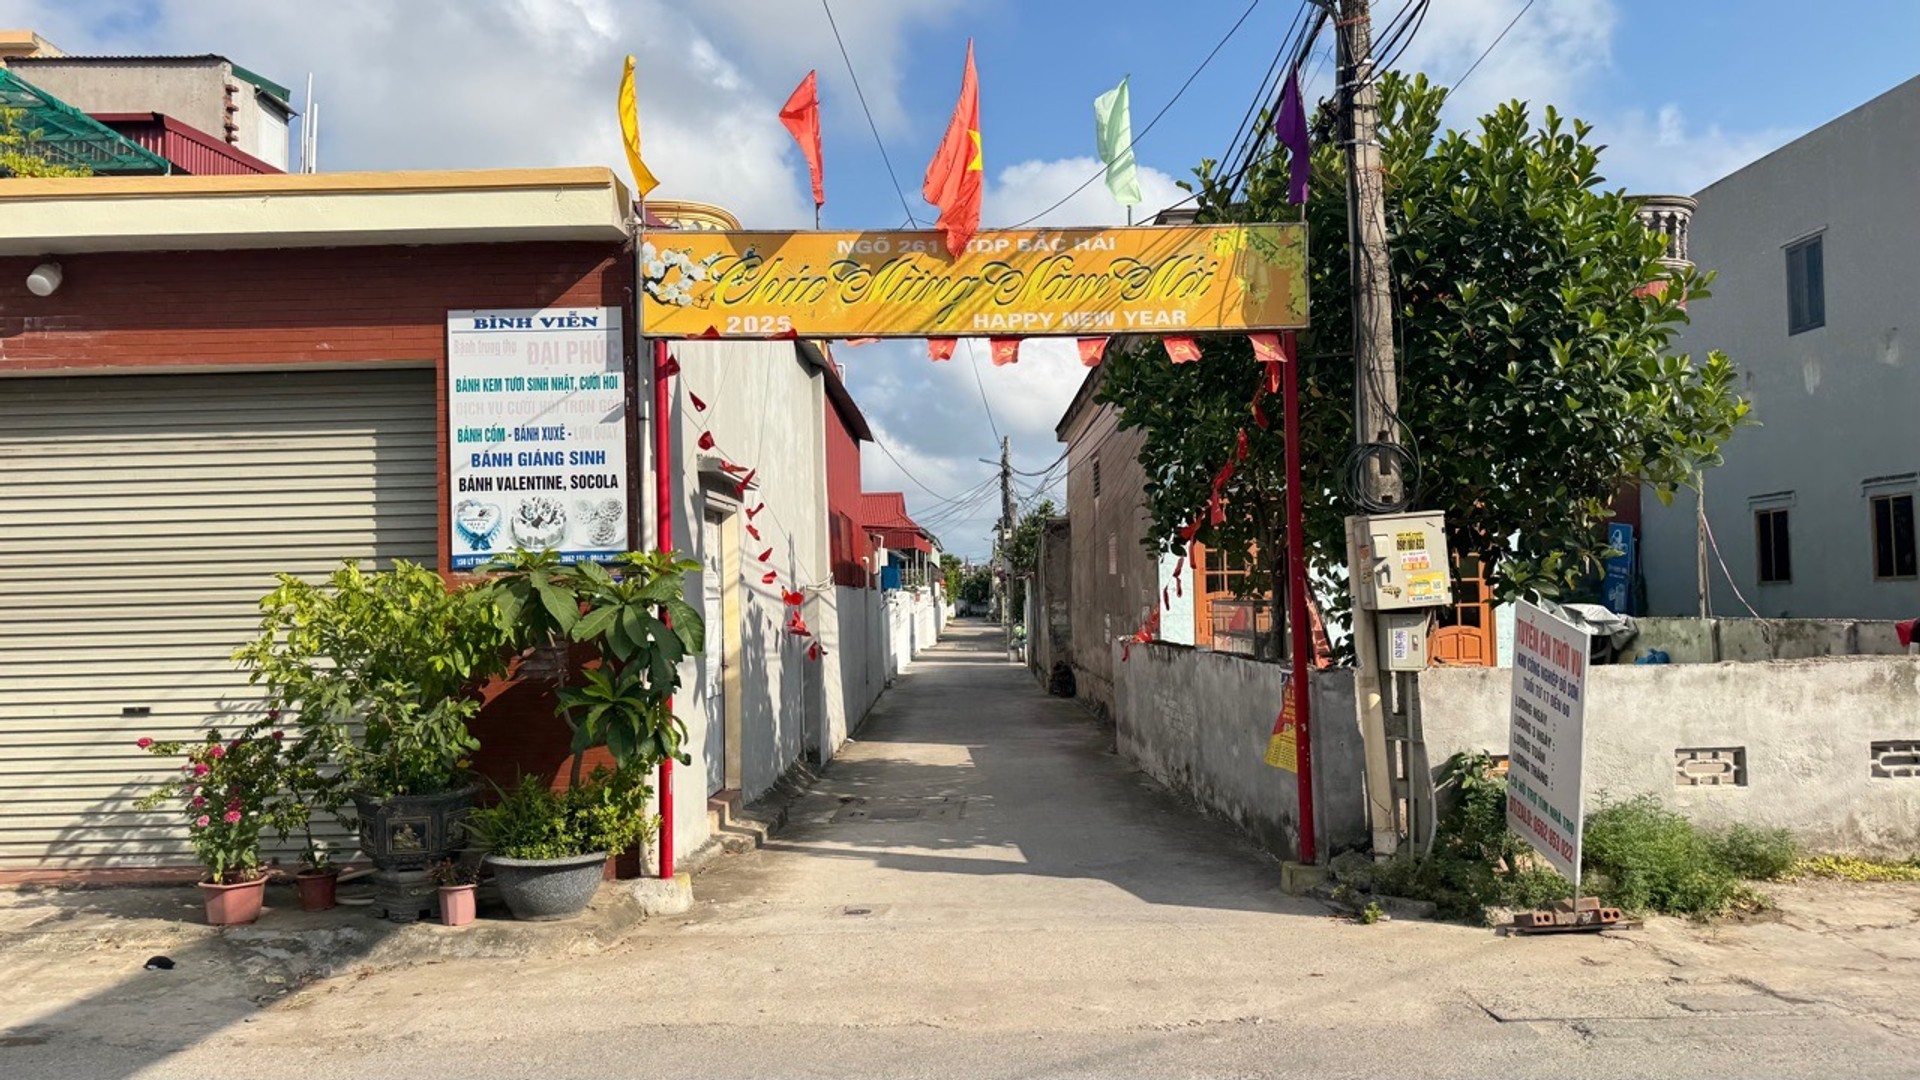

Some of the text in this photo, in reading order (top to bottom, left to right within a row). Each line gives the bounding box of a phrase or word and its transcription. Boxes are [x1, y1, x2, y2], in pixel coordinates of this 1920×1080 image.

[837, 236, 891, 254] NGÕ
[898, 240, 938, 253] 261
[708, 253, 1218, 325] Chúc Mừng Năm Mới
[474, 311, 598, 330] BÌNH VIỄN
[726, 315, 792, 334] 2025
[973, 310, 1187, 328] HAPPY NEW YEAR
[527, 336, 618, 369] ĐẠI PHÚC
[455, 375, 480, 393] BÁNH
[483, 378, 502, 392] KEM
[504, 376, 525, 392] TƯƠI
[527, 377, 549, 391] SINH
[551, 374, 577, 394] NHẬT,
[579, 372, 600, 390] CƯỚI
[457, 425, 482, 443] BÁNH
[485, 423, 505, 442] CỐM
[514, 424, 540, 442] BÁNH
[471, 449, 606, 468] BÁNH GIÁNG SINH
[459, 474, 619, 492] BÁNH VALENTINE, SOCOLA
[1517, 612, 1539, 653] TUYỂN
[1571, 647, 1582, 683] VỤ
[1527, 657, 1540, 677] CÔNG
[1540, 666, 1558, 690] NGHIỆP
[1543, 690, 1549, 704] 17
